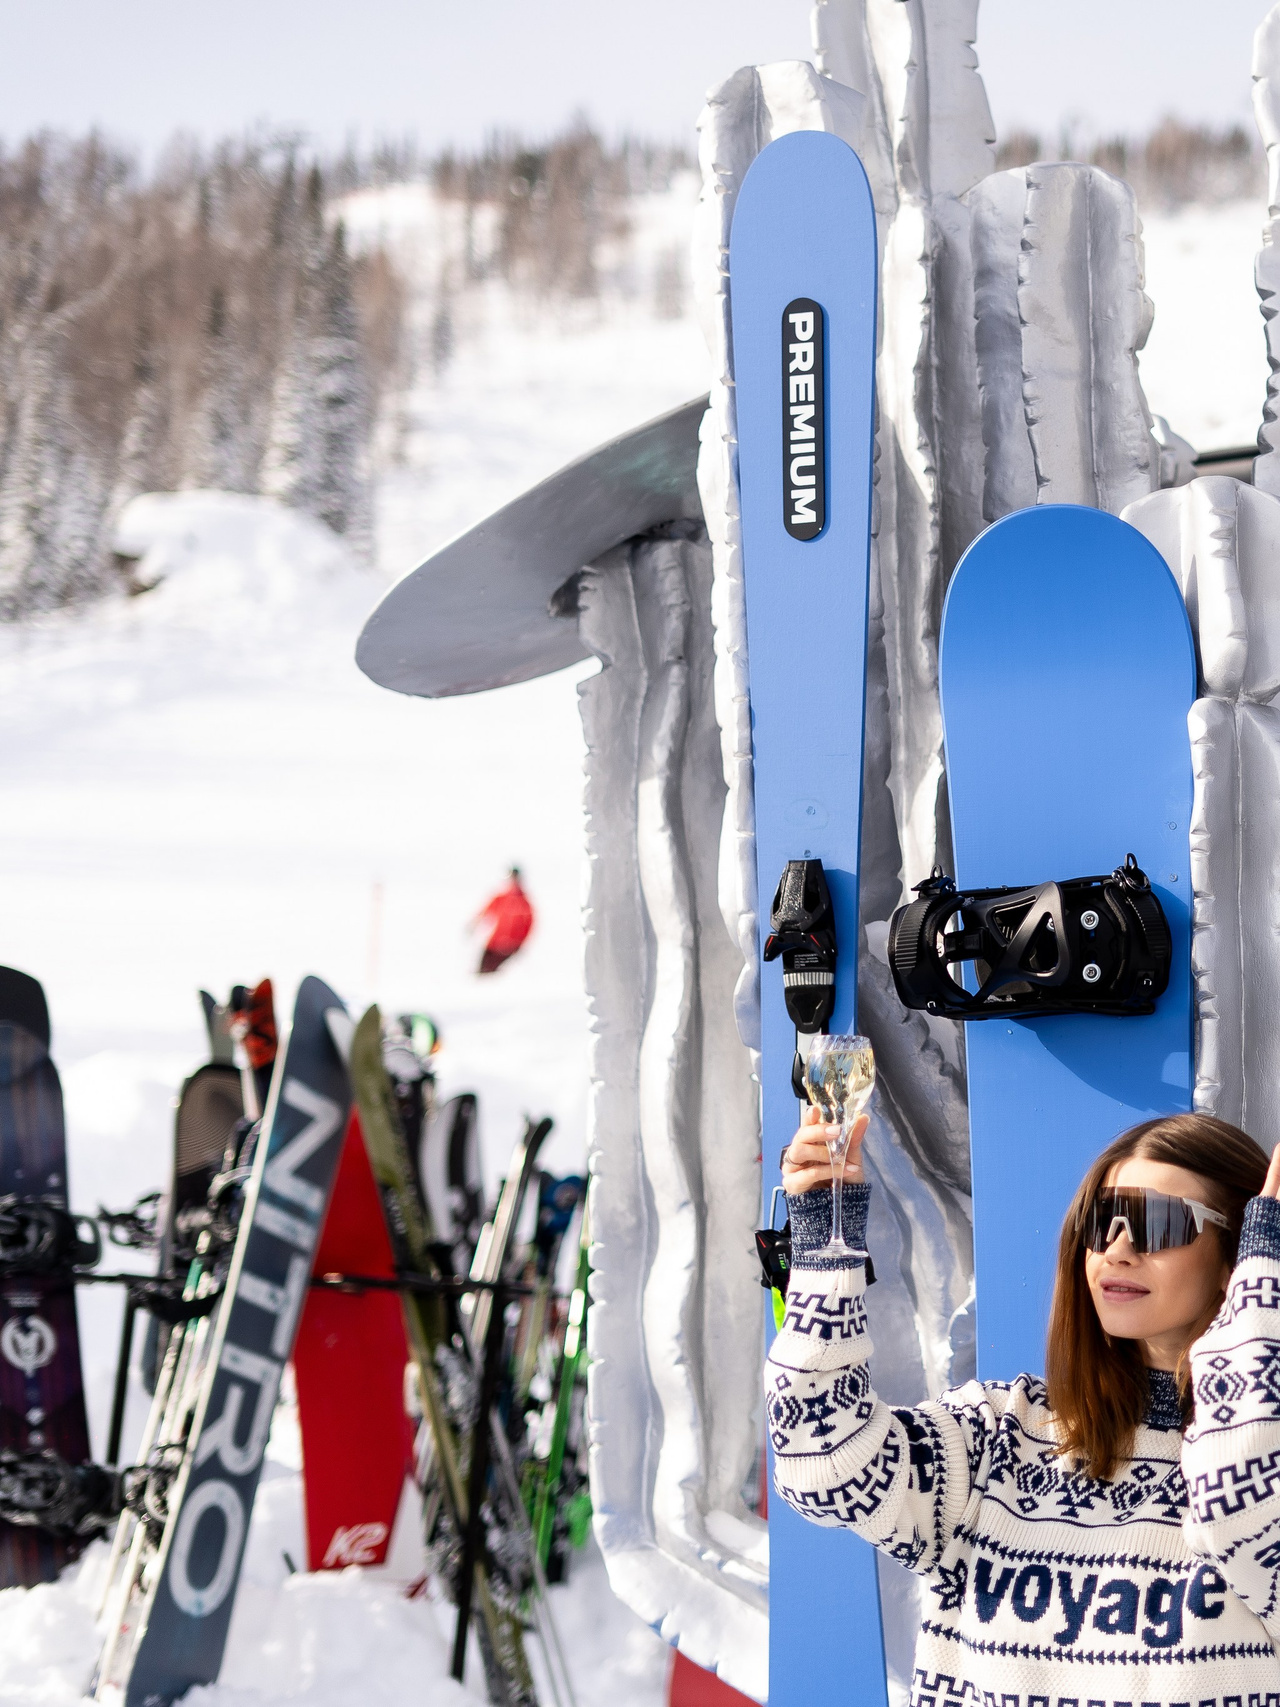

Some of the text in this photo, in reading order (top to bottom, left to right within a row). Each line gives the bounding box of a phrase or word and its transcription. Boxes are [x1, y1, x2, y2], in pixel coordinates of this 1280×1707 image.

[788, 311, 817, 524] PREMIUM
[168, 1077, 345, 1616] NITRO
[322, 1521, 389, 1567] K2
[974, 1557, 1227, 1649] voyage
